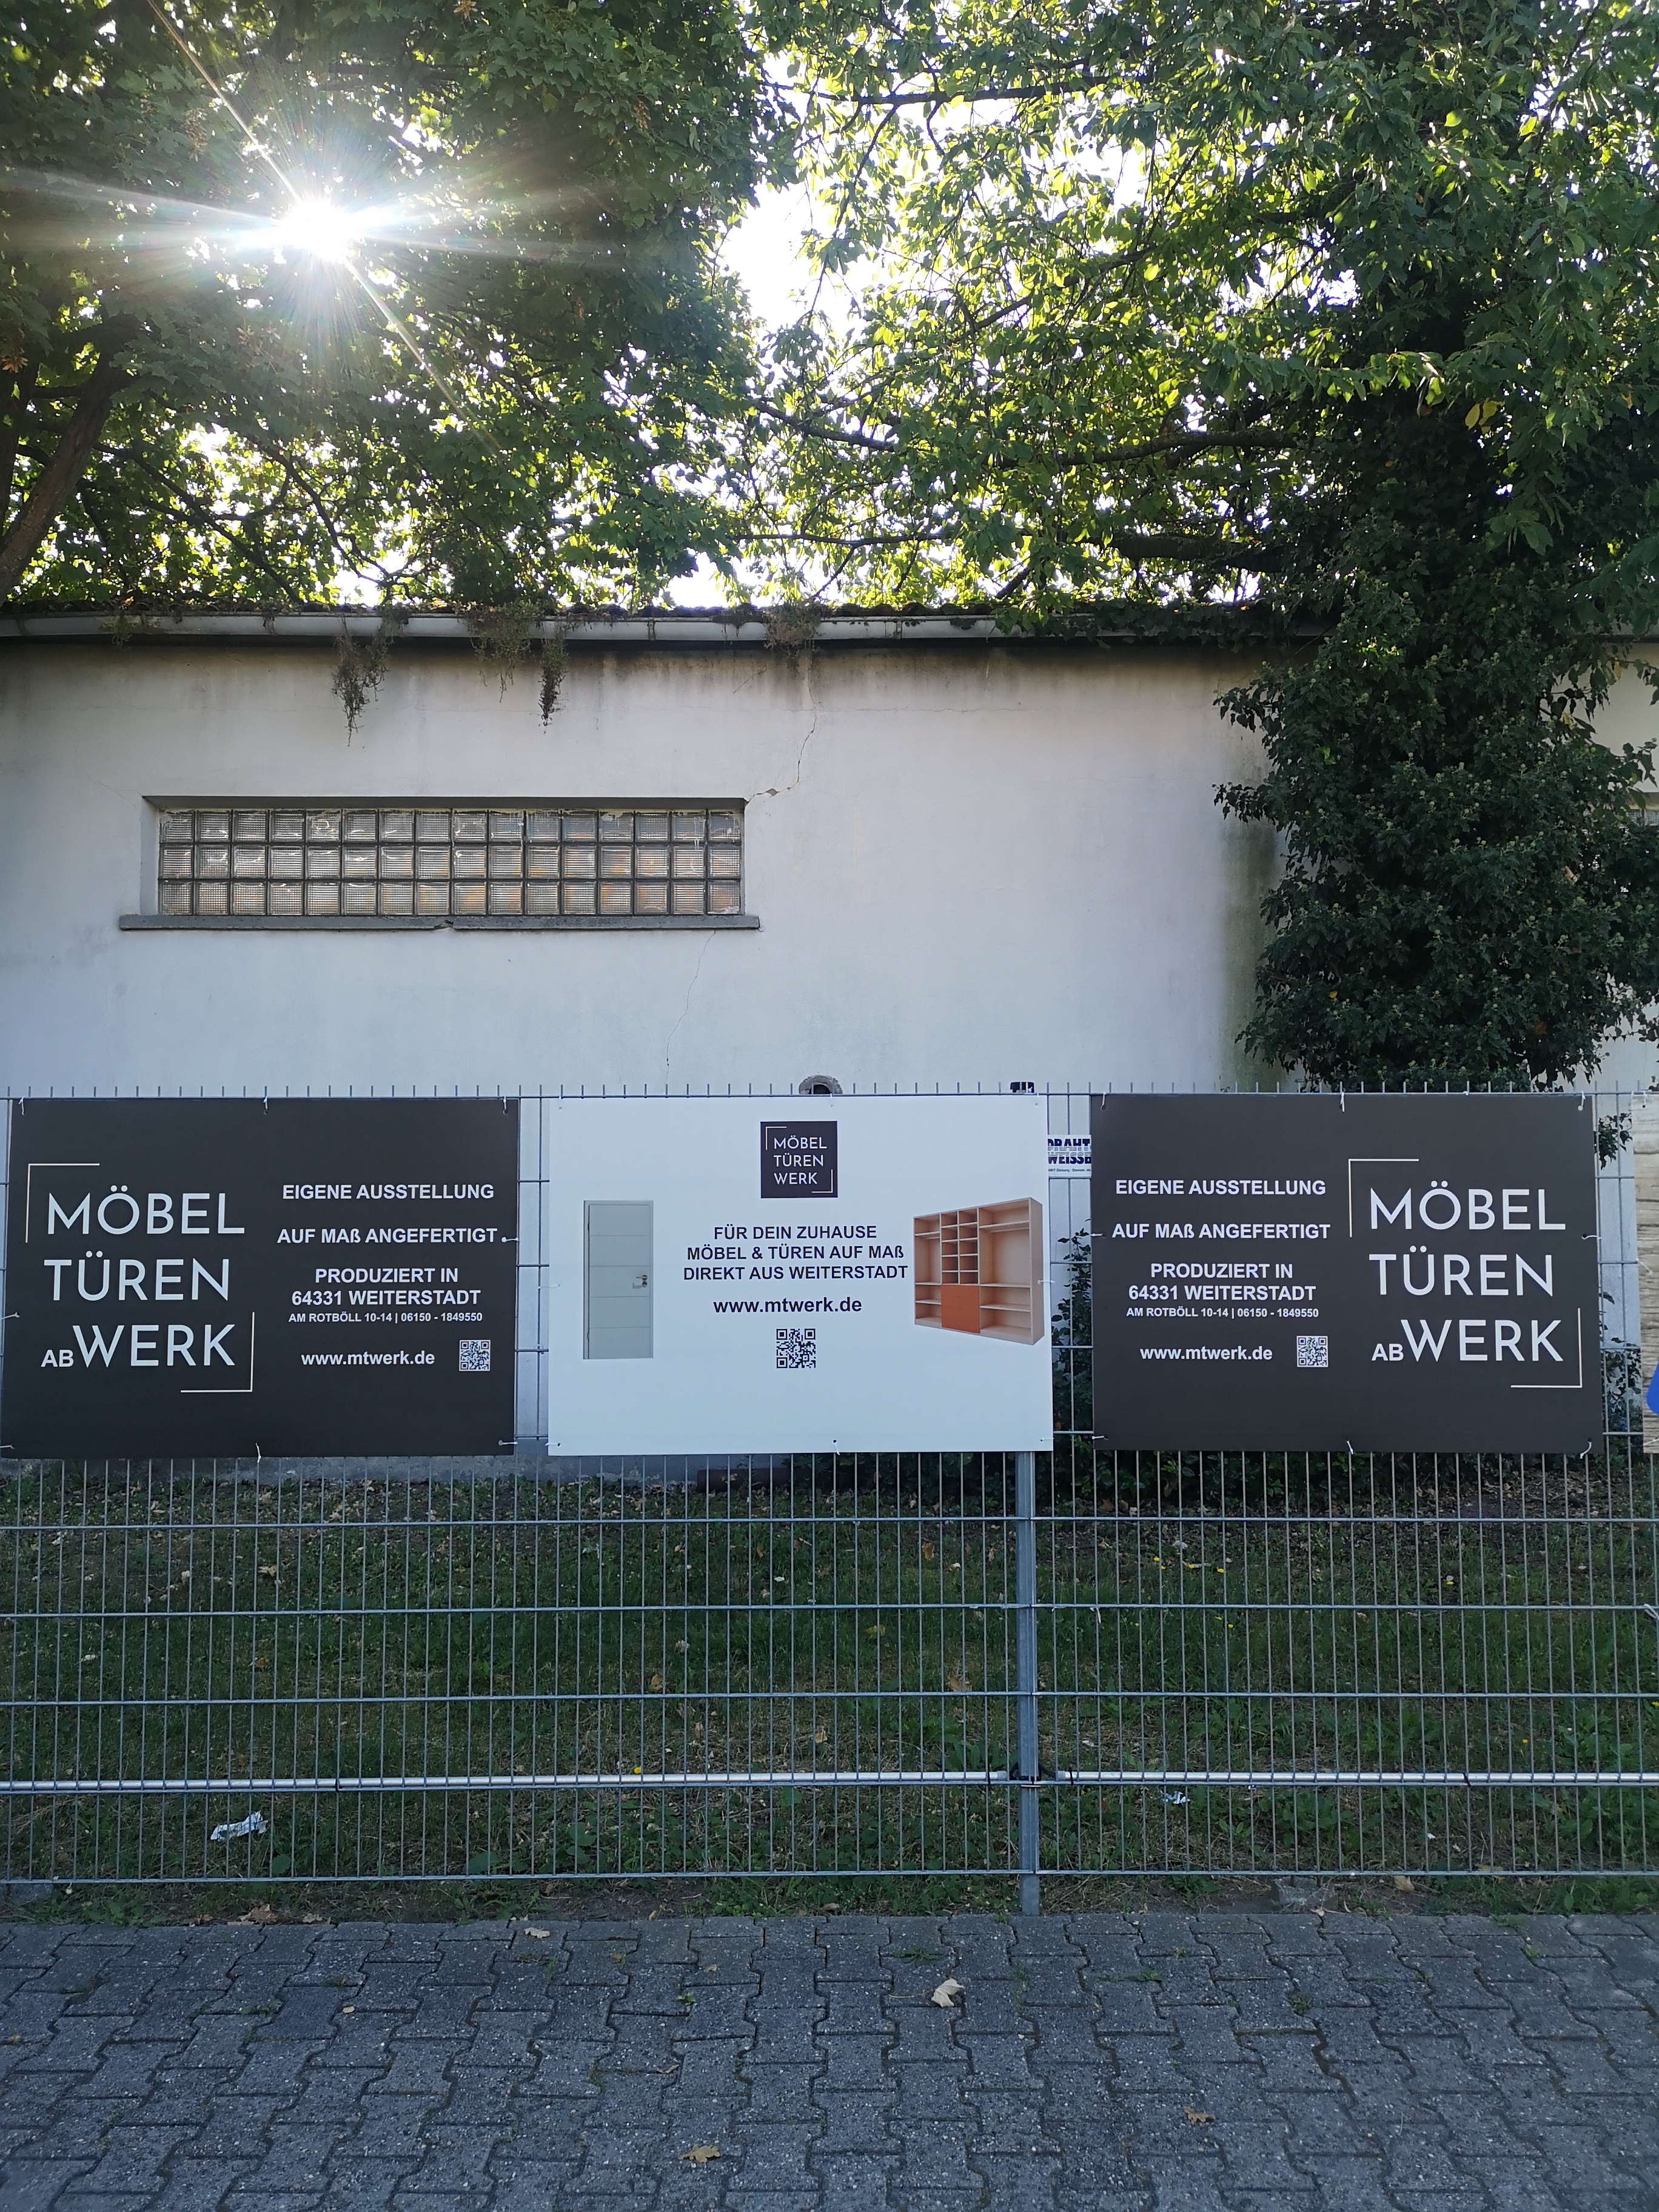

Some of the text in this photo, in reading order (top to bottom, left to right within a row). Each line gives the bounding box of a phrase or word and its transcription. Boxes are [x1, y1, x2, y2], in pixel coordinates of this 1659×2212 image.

[774, 1134, 828, 1150] MÖBEL
[773, 1152, 823, 1167] TÜREN
[773, 1172, 817, 1185] WERK
[283, 1184, 494, 1199] EIGENE AUSSTELLUNG
[1116, 1179, 1326, 1195] EIGENE AUSSTELLUNG
[47, 1185, 245, 1235] MÖBEL
[1370, 1180, 1566, 1230] MÖBEL
[276, 1228, 498, 1244] AUF MAß ANGEFERTIGT
[714, 1224, 877, 1240] FÜR DEIN ZUHAUSE
[1111, 1223, 1331, 1239] AUF MAß ANGEFERTIGT
[687, 1243, 904, 1260] MÖBEL & TÜREN AUF MAß
[44, 1250, 229, 1301] TÜREN
[315, 1267, 458, 1283] PRODUZIERT IN
[683, 1265, 908, 1281] DIREKT AUS WEITERSTADT
[1151, 1263, 1293, 1279] PRODUZIERT IN
[1369, 1245, 1553, 1297] TÜREN
[292, 1290, 481, 1305] 64331 WEITERSTADT
[1128, 1285, 1316, 1301] 64331 WEITERSTADT
[712, 1296, 862, 1313] www.mtwerk.de
[1126, 1307, 1144, 1317] AM
[1146, 1305, 1199, 1317] ROTBÖLL
[1201, 1307, 1229, 1317] 10-14
[1237, 1307, 1268, 1318] 06150
[1276, 1308, 1319, 1318] 1849550
[288, 1313, 306, 1322] AM
[309, 1310, 362, 1322] ROTBÖLL
[364, 1312, 392, 1322] 10-14
[401, 1312, 431, 1322] 06150
[441, 1312, 483, 1322] 1849550
[41, 1324, 235, 1368] AB WERK
[1371, 1319, 1564, 1362] AB WERK
[301, 1350, 435, 1366] www.mtwerk.de
[1139, 1346, 1273, 1360] www.mtwerk.de
